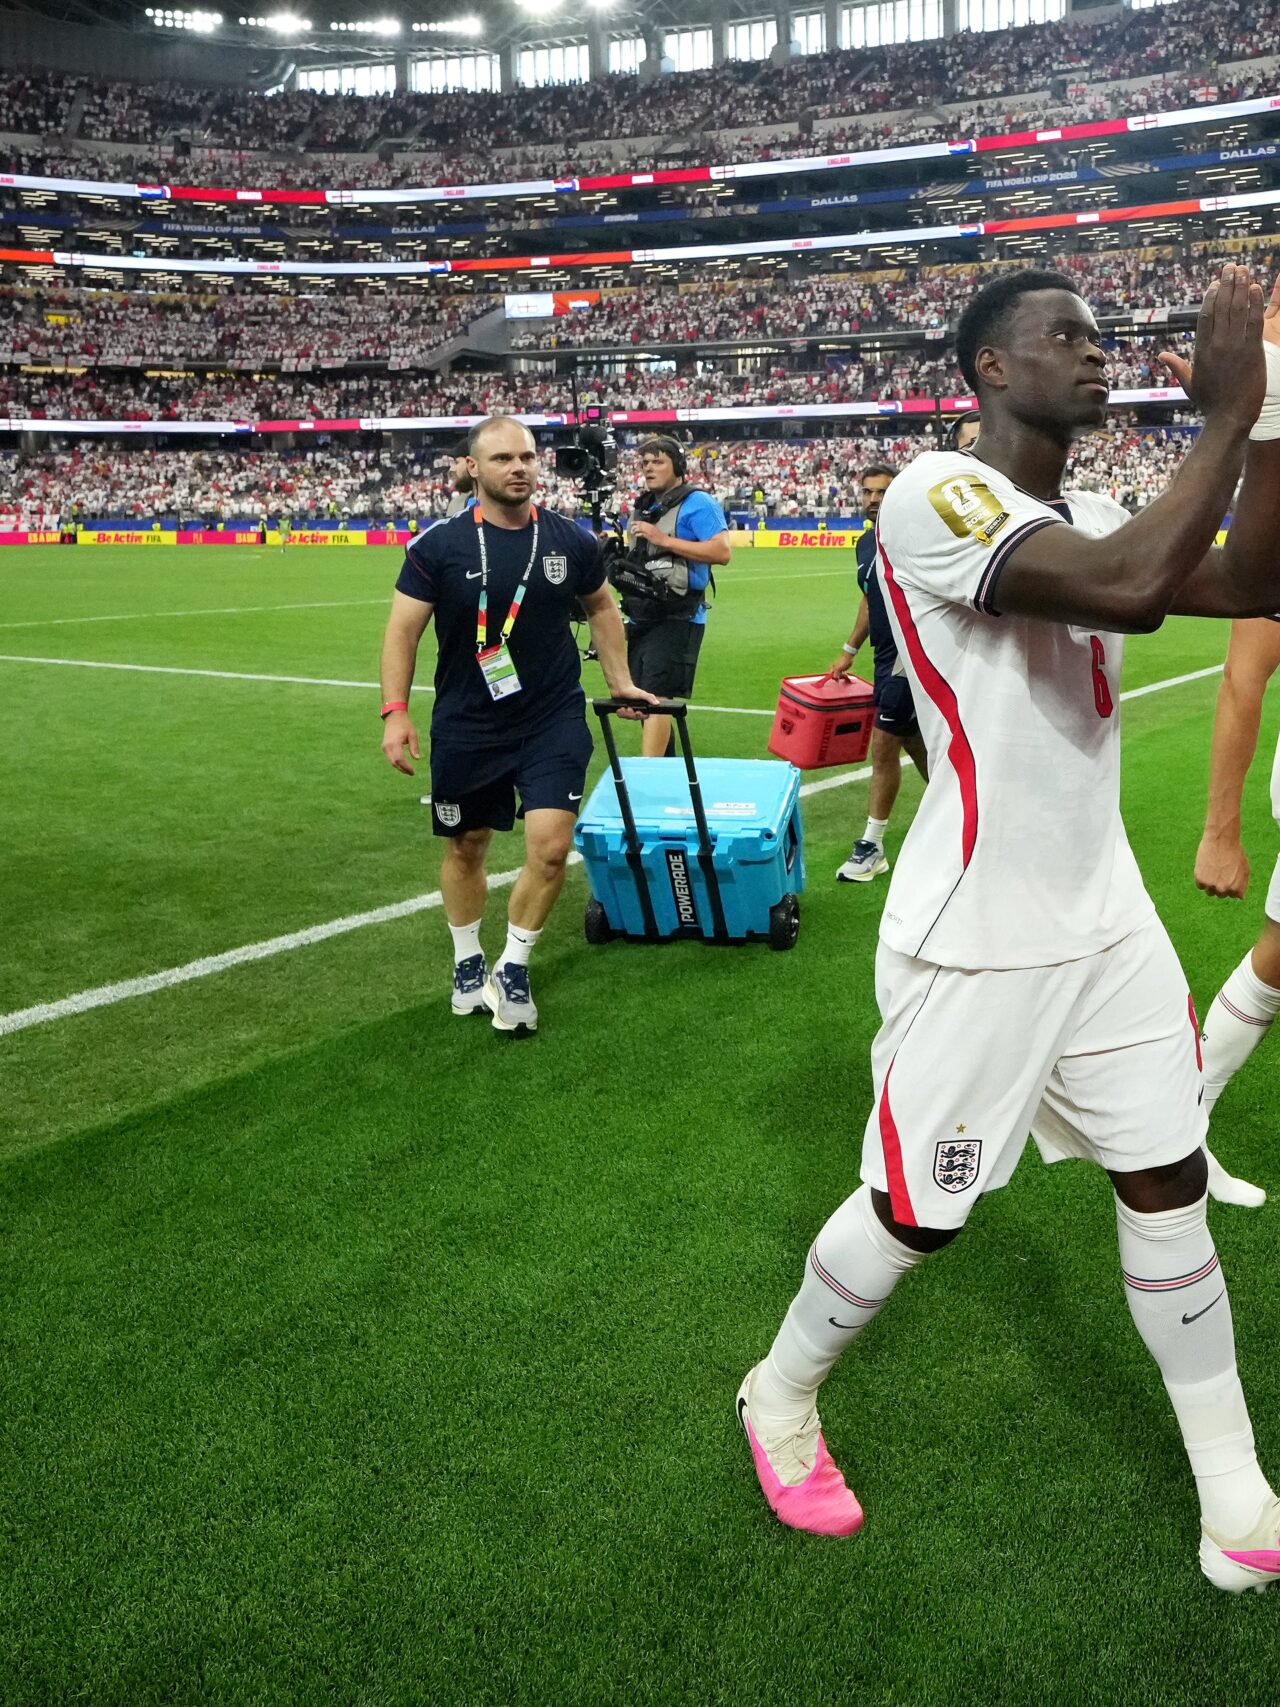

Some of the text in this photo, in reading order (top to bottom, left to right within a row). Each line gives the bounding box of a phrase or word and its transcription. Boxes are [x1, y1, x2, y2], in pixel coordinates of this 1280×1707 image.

[1219, 146, 1277, 160] DALLAS
[986, 171, 1078, 188] FIFA WORLD CUP 2026
[811, 195, 858, 207] DALLAS
[162, 223, 182, 231] FIFA
[182, 225, 214, 233] WORLD
[391, 226, 436, 234] DALLAS
[97, 533, 161, 543] Be Active FIFA
[298, 532, 328, 544] Active
[332, 535, 349, 543] FIFA
[779, 532, 799, 546] Be
[801, 532, 846, 547] Active
[1090, 635, 1114, 718] 6
[668, 854, 695, 922] POWERADE
